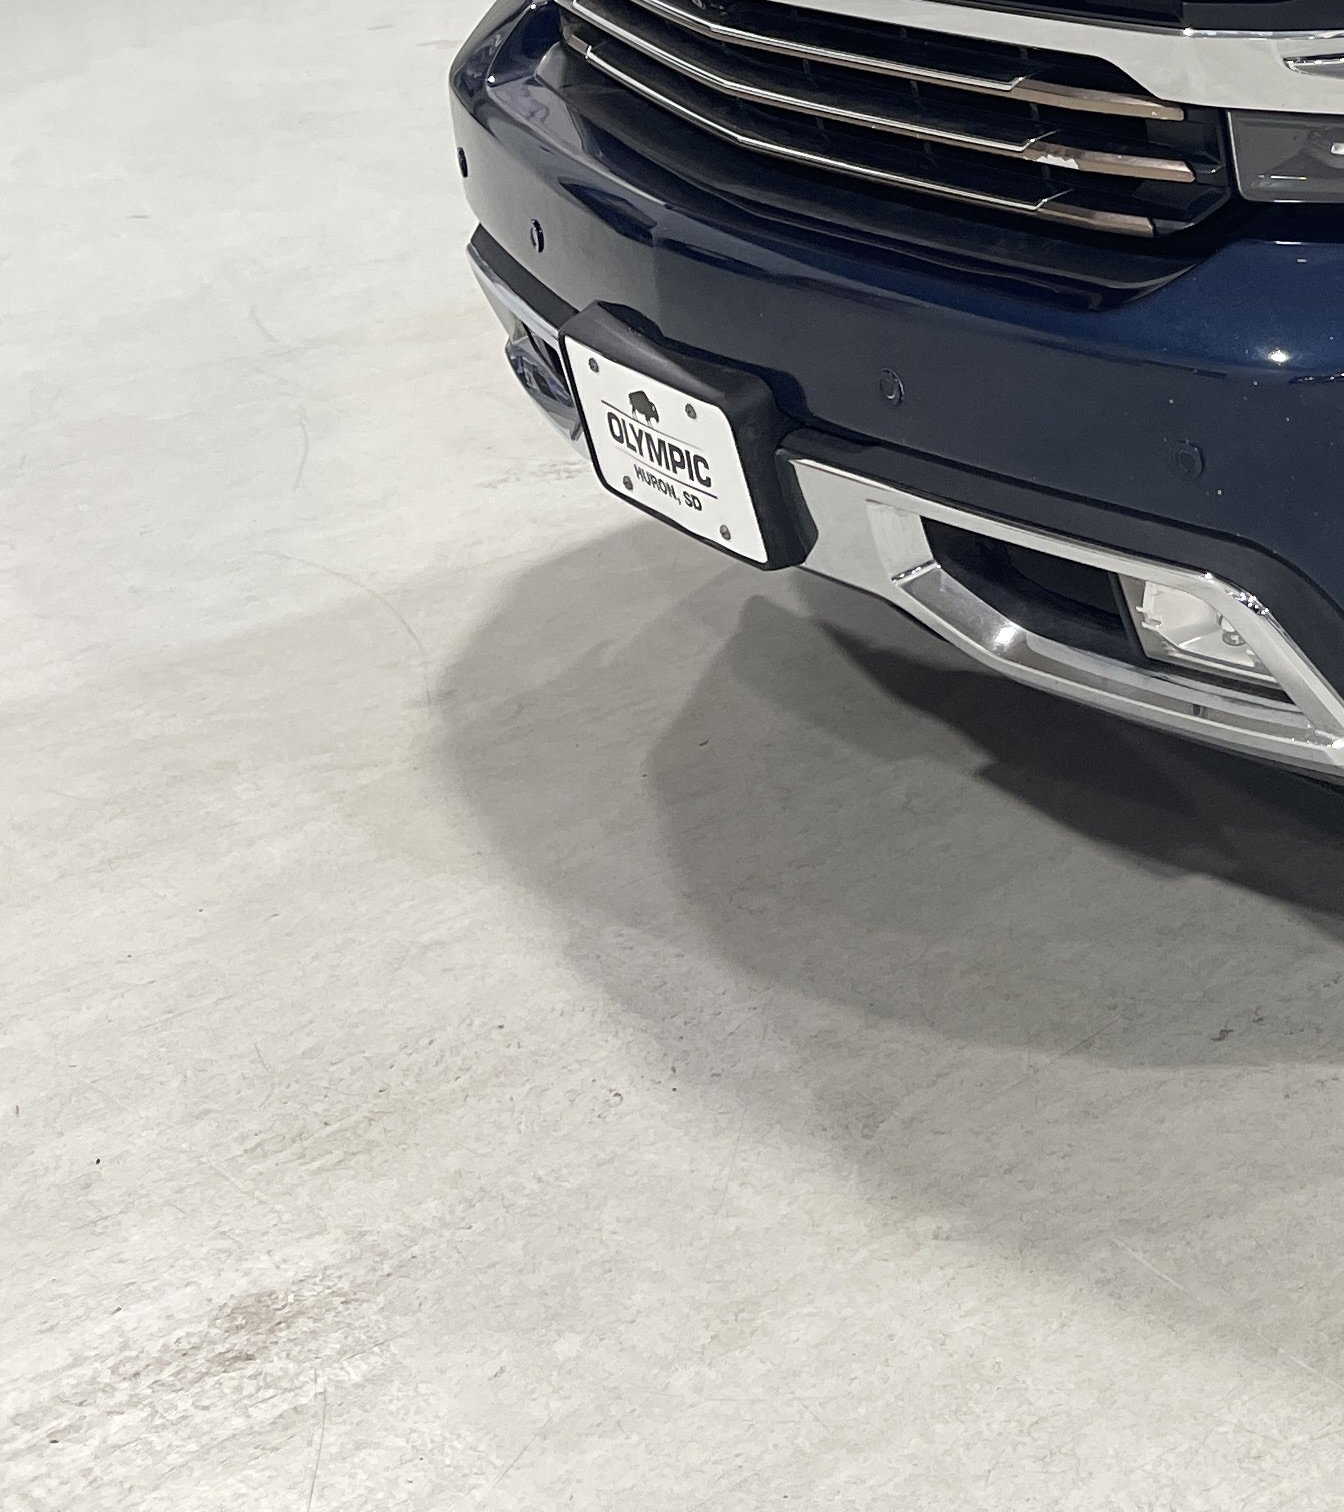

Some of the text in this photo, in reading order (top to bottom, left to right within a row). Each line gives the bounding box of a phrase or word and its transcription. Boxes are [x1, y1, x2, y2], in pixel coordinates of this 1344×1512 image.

[607, 411, 712, 487] OLYMPIC
[633, 462, 703, 511] HURON, SD
